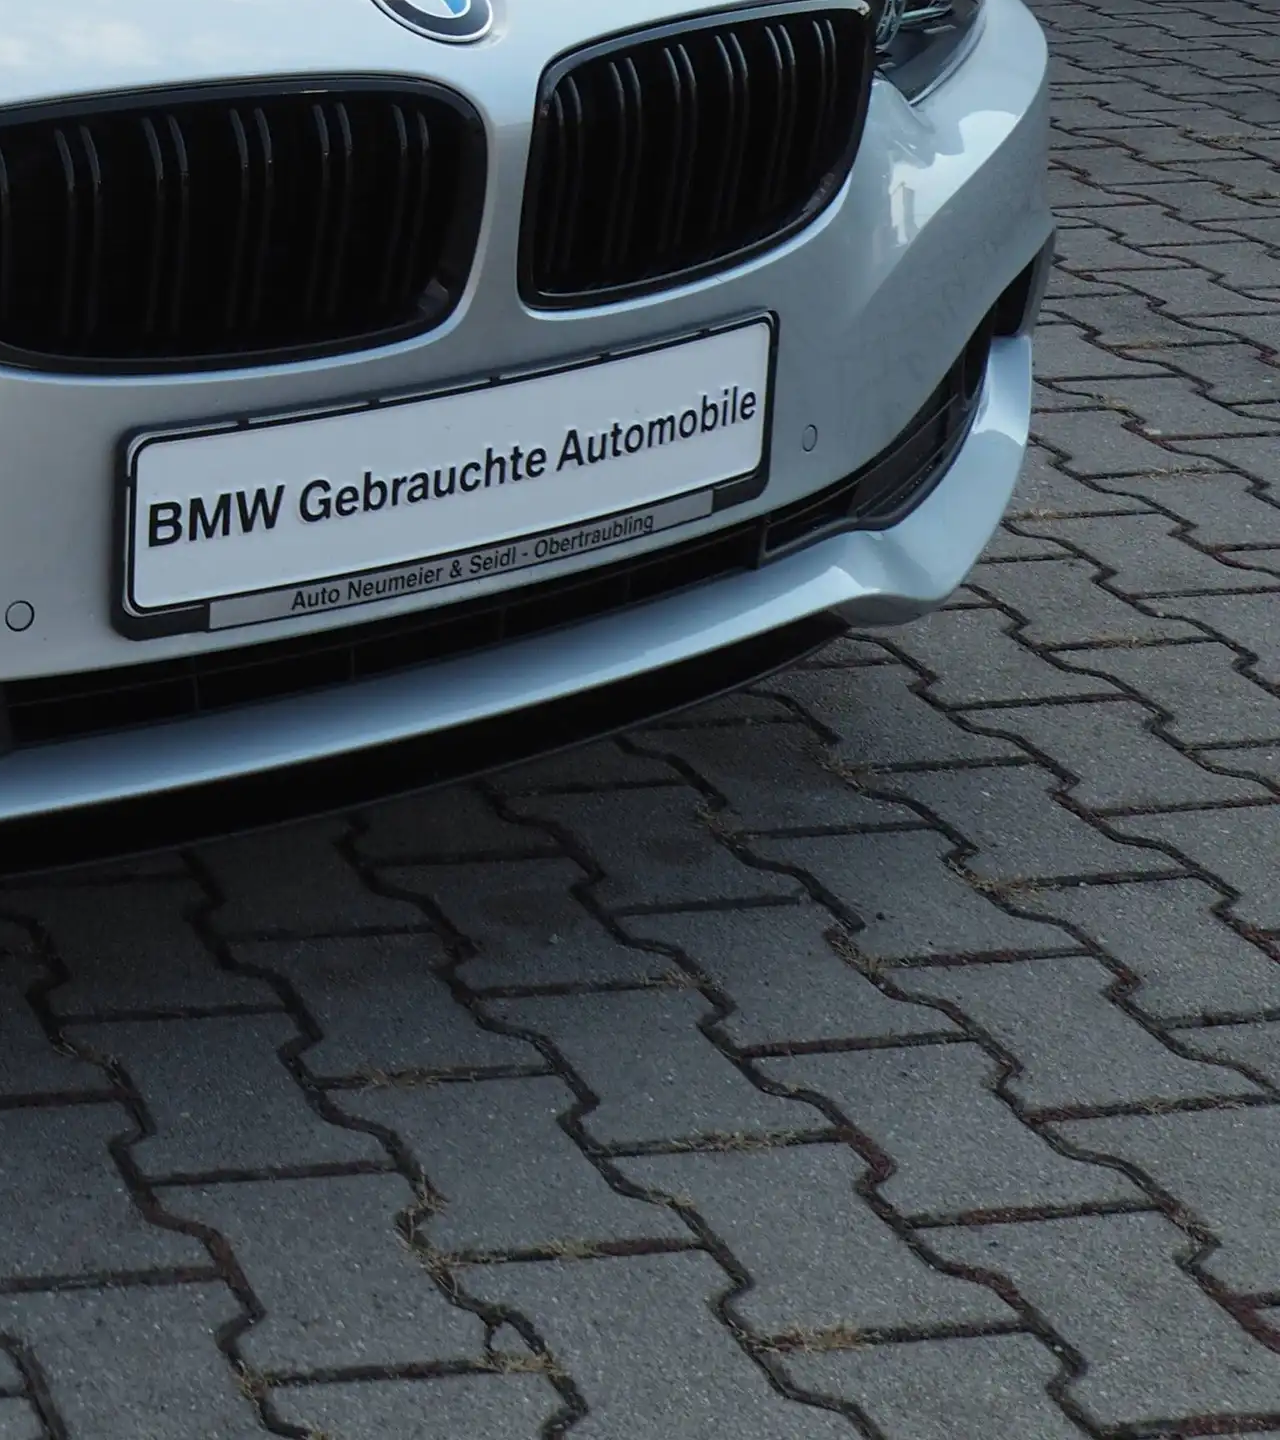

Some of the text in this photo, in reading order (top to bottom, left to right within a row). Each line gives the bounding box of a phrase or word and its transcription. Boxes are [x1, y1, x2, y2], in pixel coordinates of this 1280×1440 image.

[147, 387, 759, 549] BMW Gebrauchte Automobile
[290, 587, 341, 611] Auto
[347, 566, 445, 599] Neumeier
[449, 558, 463, 578] &
[469, 545, 518, 575] Seidl
[534, 512, 655, 559] Obertraubling
